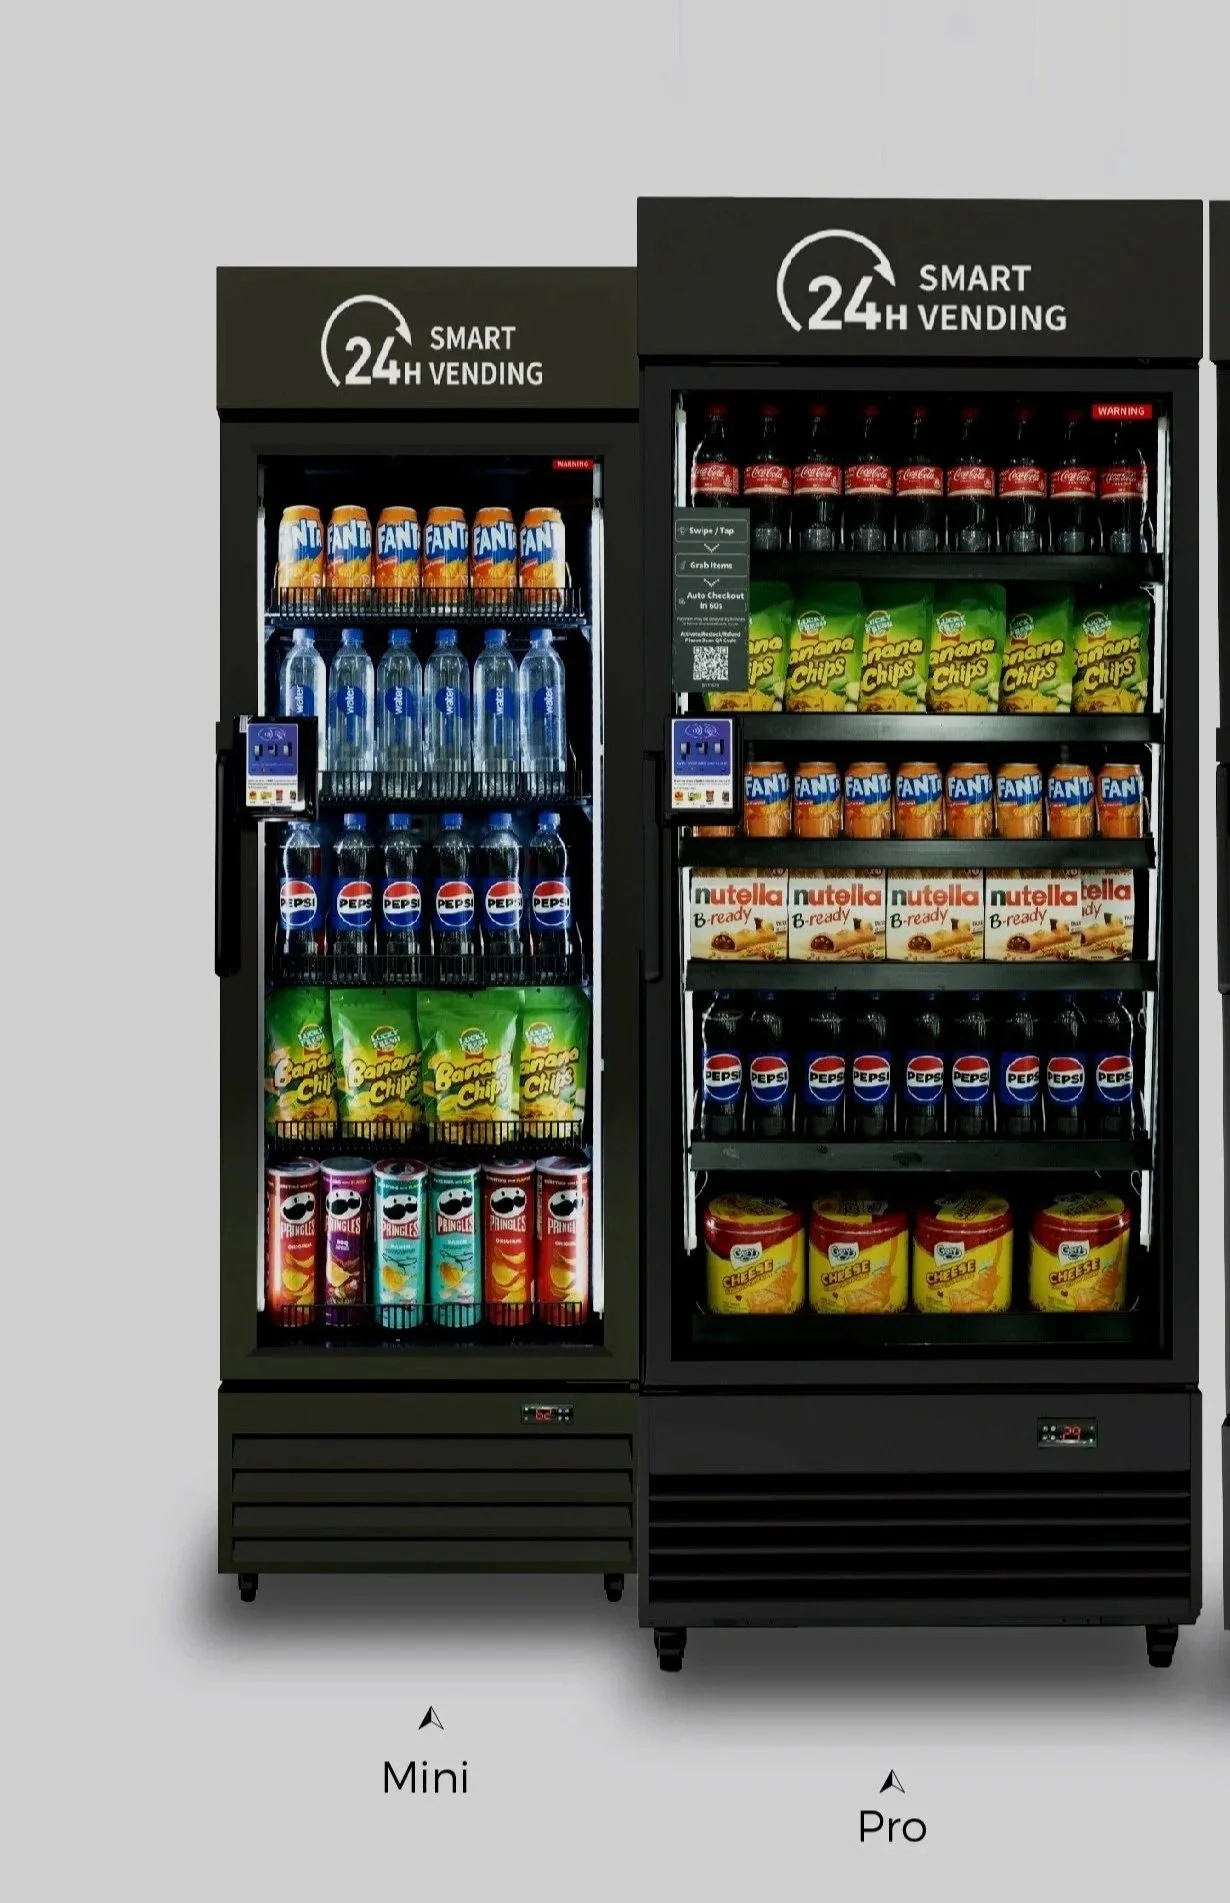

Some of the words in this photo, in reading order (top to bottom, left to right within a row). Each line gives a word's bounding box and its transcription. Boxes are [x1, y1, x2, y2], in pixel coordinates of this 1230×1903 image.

[808, 275, 907, 331] 24H
[918, 263, 1032, 292] SMART
[917, 304, 1068, 332] VENDING
[344, 335, 421, 386] 24H
[429, 325, 517, 351] SMART
[428, 361, 544, 386] VENDING
[1097, 406, 1145, 417] WARNING
[689, 526, 713, 536] Swipe
[719, 526, 735, 537] Tap
[689, 560, 710, 570] Grab
[711, 560, 733, 570] Items
[686, 591, 706, 600] Auto
[707, 591, 745, 600] Checkout
[791, 656, 846, 691] Chips
[862, 659, 914, 692] Chips
[933, 658, 987, 691] Chips
[1003, 661, 1056, 692] Chips
[1084, 656, 1135, 692] Chips
[296, 684, 305, 714] water
[346, 685, 355, 716] water
[393, 685, 403, 716] water
[446, 685, 455, 716] water
[495, 685, 504, 716] water
[544, 685, 554, 716] water
[745, 772, 790, 798] FANT
[794, 772, 840, 798] FANT
[845, 773, 891, 799] FANT
[896, 774, 942, 799] FANT
[947, 774, 993, 799] FANT
[997, 774, 1042, 799] FANT
[1048, 775, 1093, 799] FANT
[1101, 775, 1143, 799] FANT
[695, 882, 783, 907] nutella
[793, 882, 882, 907] nutella
[891, 882, 980, 907] nutella
[990, 882, 1078, 907] nutella
[1081, 878, 1131, 900] tella
[693, 906, 752, 929] B-ready
[791, 906, 851, 930] B-ready
[889, 906, 949, 930] B-ready
[989, 906, 1047, 930] B-ready
[520, 1046, 580, 1075] anana
[368, 1069, 419, 1104] Chips
[457, 1073, 507, 1107] Chips
[519, 1067, 576, 1099] Chips
[1008, 1072, 1040, 1084] PEPS
[281, 1223, 316, 1238] PRINGLES
[381, 1222, 419, 1238] PRINGLES
[437, 1216, 474, 1233] PRINGLES
[489, 1215, 527, 1233] PRINGLES
[722, 1259, 774, 1289] CHEESE
[821, 1259, 871, 1287] CHEESE
[925, 1259, 976, 1286] CHEESE
[1049, 1258, 1101, 1286] CHEESE
